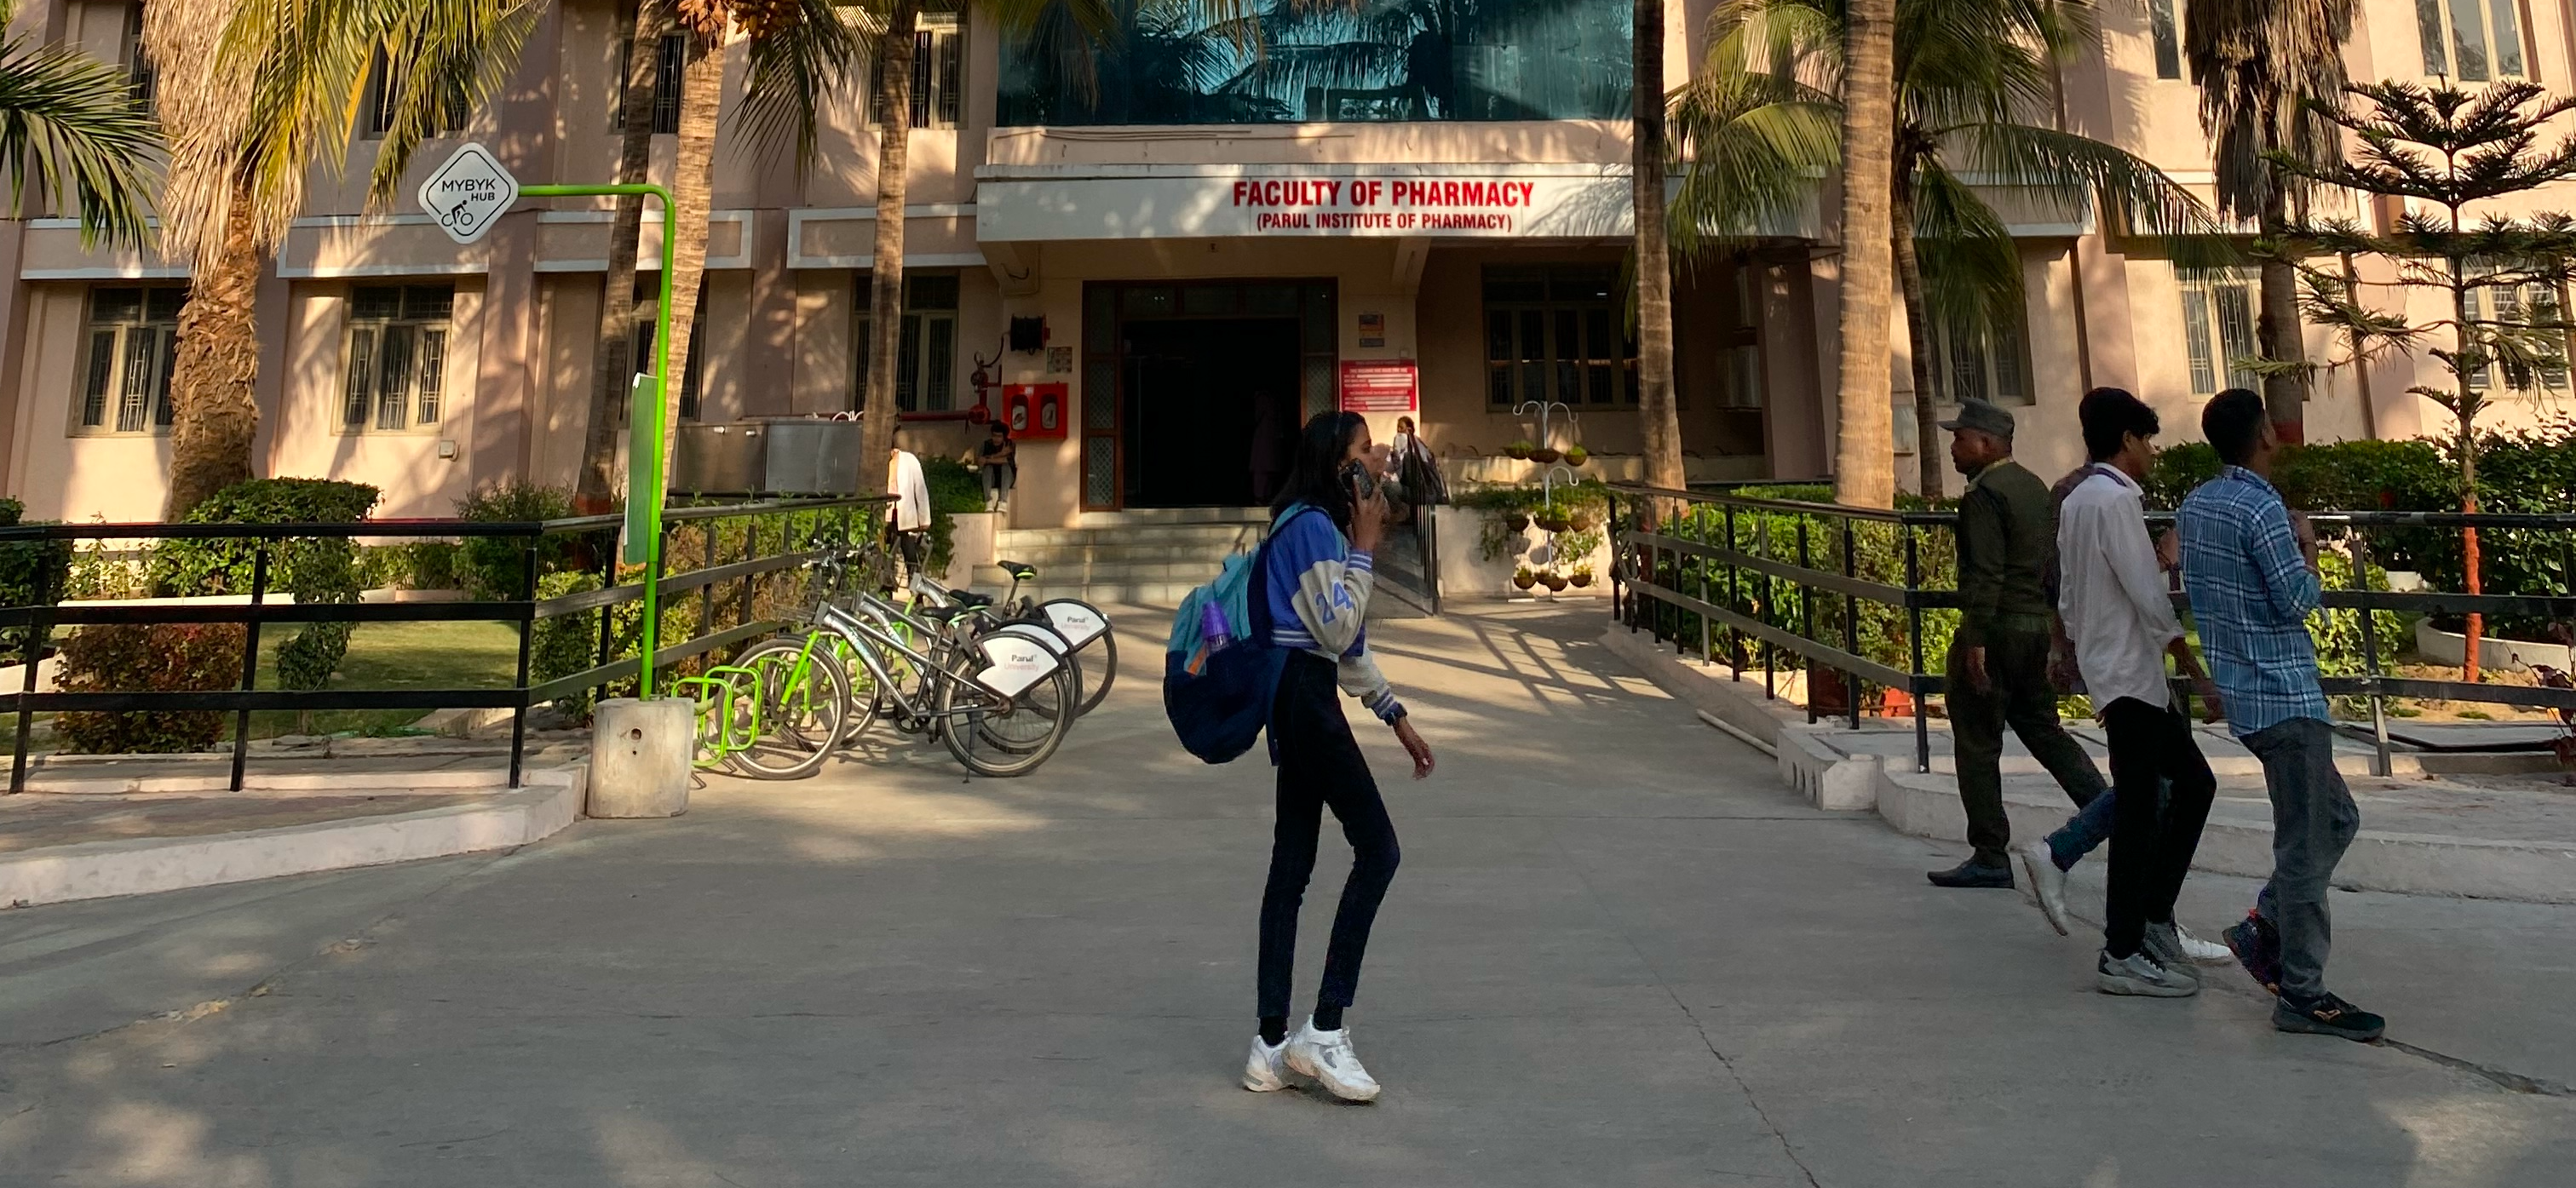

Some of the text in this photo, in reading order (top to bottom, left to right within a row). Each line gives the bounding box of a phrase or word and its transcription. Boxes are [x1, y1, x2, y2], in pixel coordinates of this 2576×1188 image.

[441, 178, 496, 192] MYBYK
[1233, 180, 1534, 207] FACULTY OF PHARMACY
[470, 192, 496, 201] HUB
[1256, 213, 1512, 232] (PARUL INSTITUTE OF PHARMACY)
[1315, 582, 1353, 625] 24
